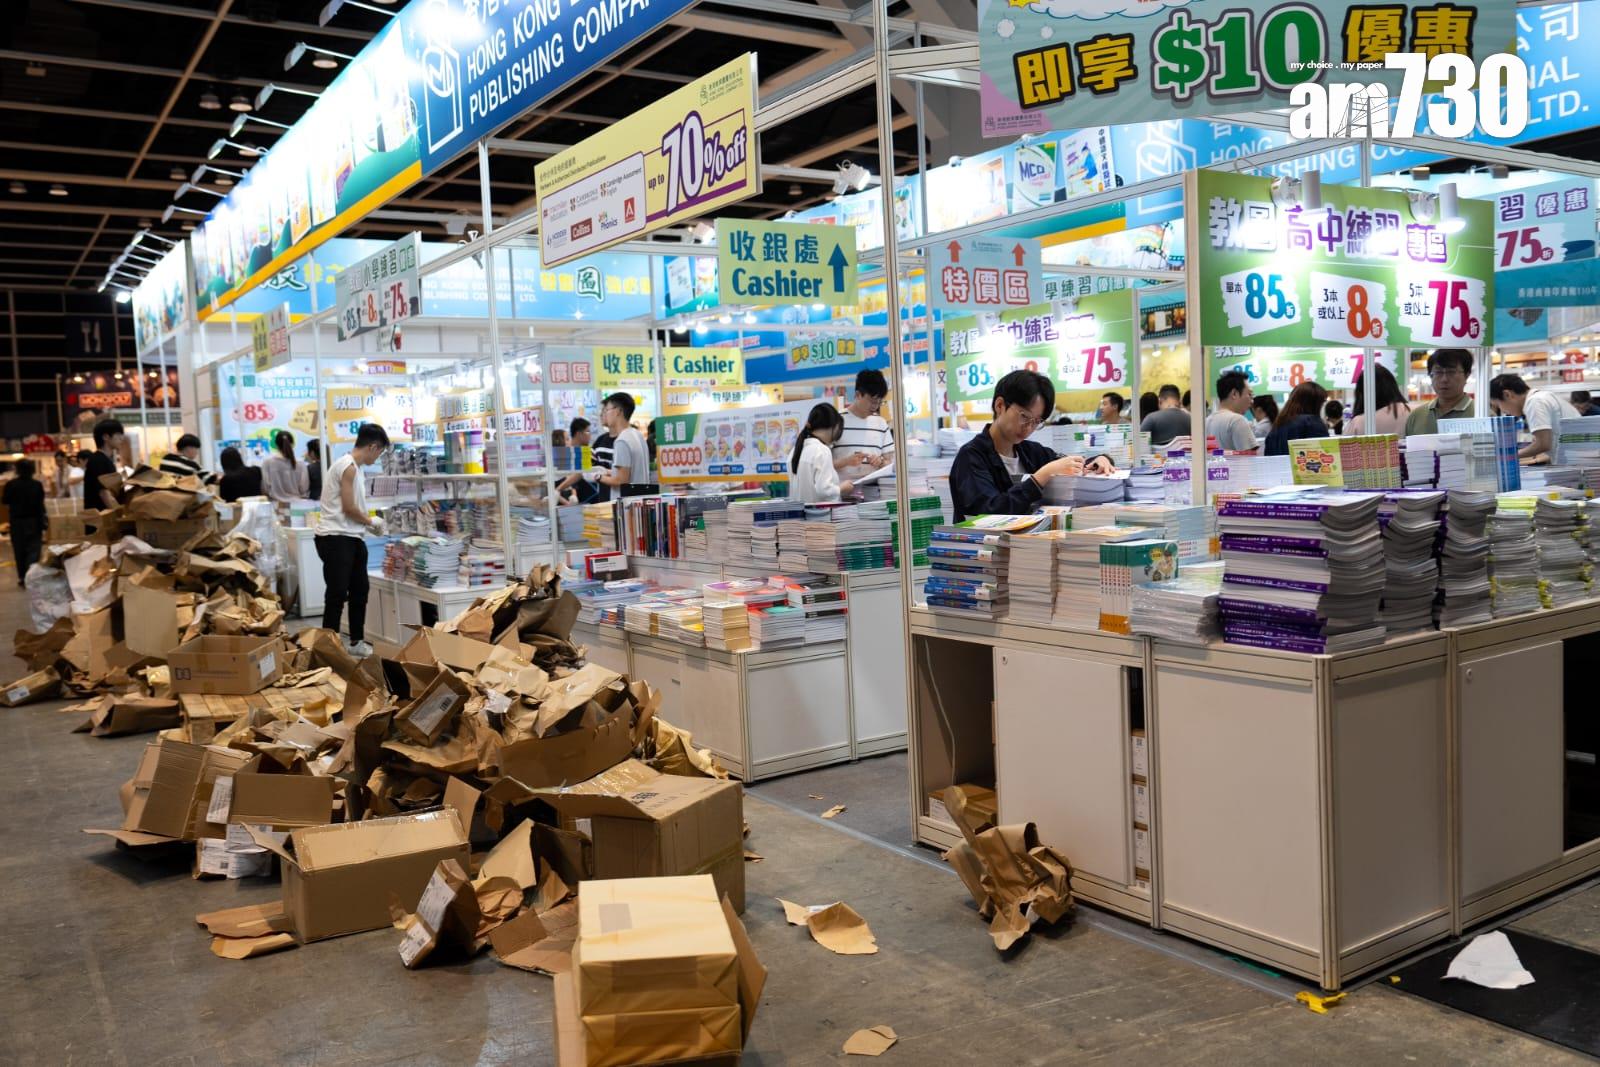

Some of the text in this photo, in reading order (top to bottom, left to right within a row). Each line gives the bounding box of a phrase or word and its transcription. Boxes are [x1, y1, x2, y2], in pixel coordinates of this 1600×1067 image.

[467, 28, 507, 84] HONG
[1014, 33, 1138, 109] 即享
[1150, 2, 1328, 101] $10
[469, 32, 564, 125] PUBLISHING
[729, 230, 820, 265] 收銀處
[732, 267, 823, 297] Cashier
[942, 266, 1030, 305] 特價區
[673, 354, 735, 374] Cashier
